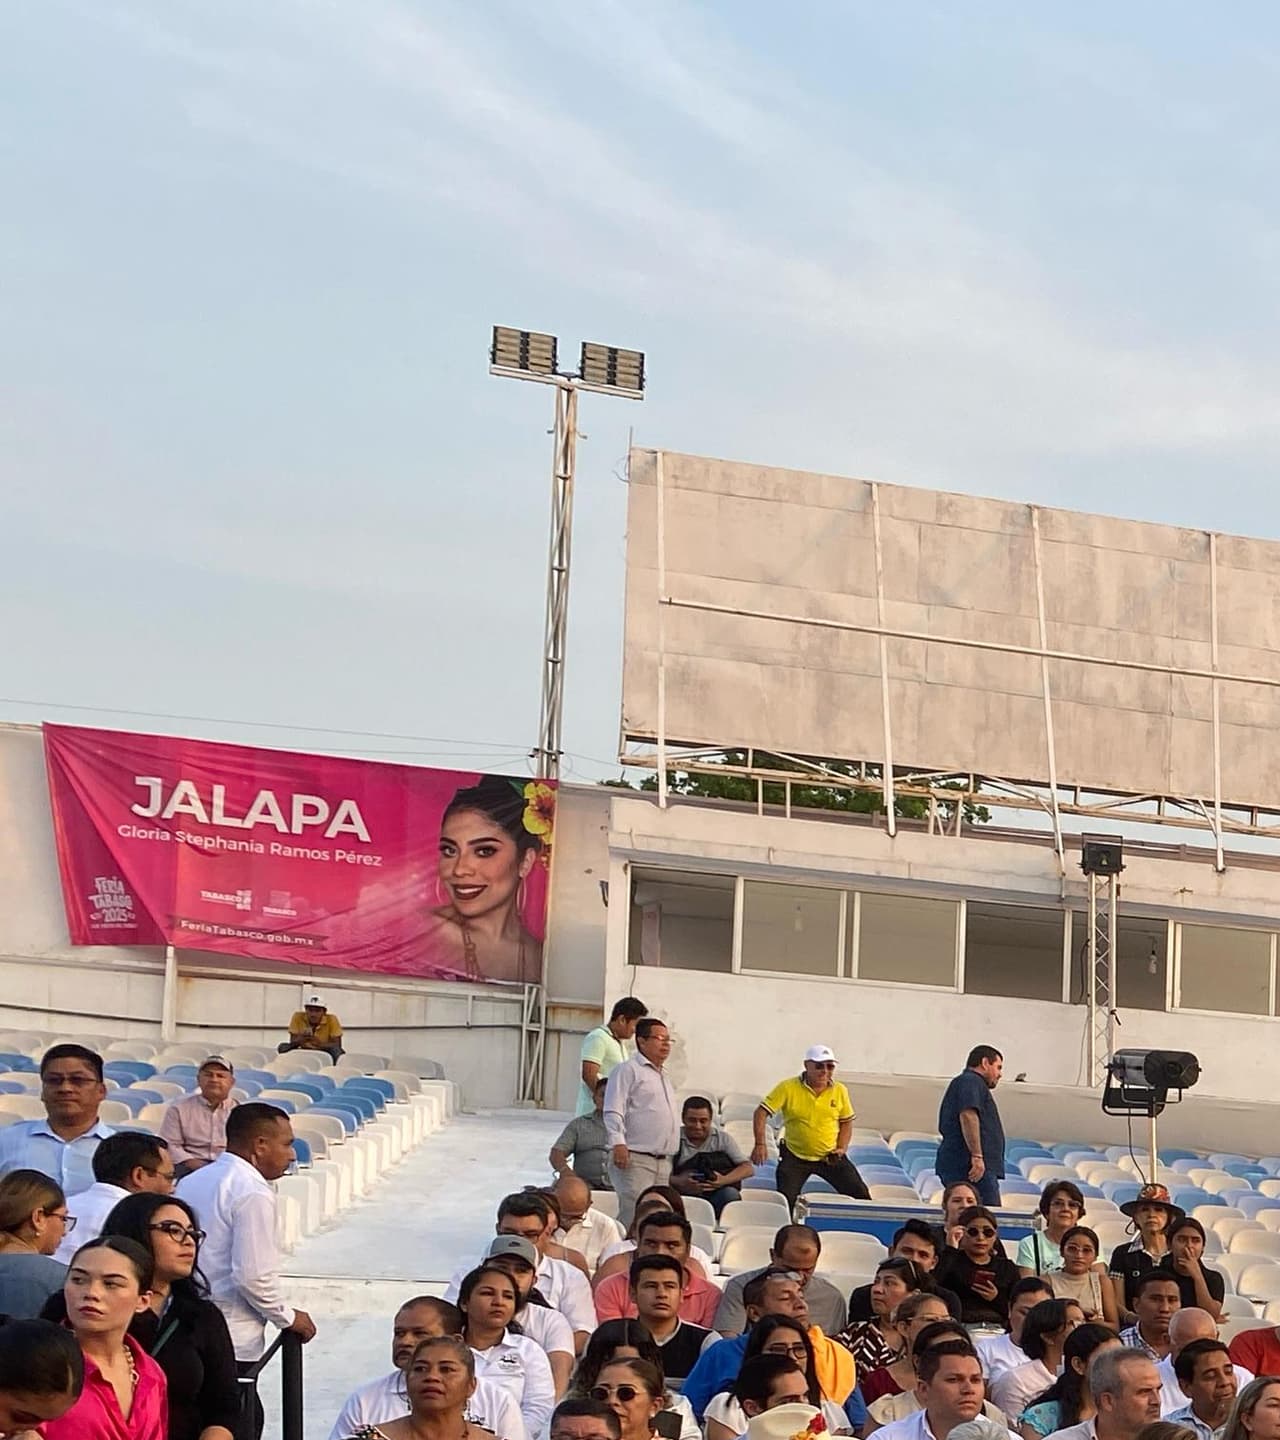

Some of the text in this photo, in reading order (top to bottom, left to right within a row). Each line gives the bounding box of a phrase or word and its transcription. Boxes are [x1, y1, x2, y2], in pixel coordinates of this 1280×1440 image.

[131, 776, 371, 843] JALAPA
[118, 824, 382, 867] Gloria Stephania Ramos Pérez
